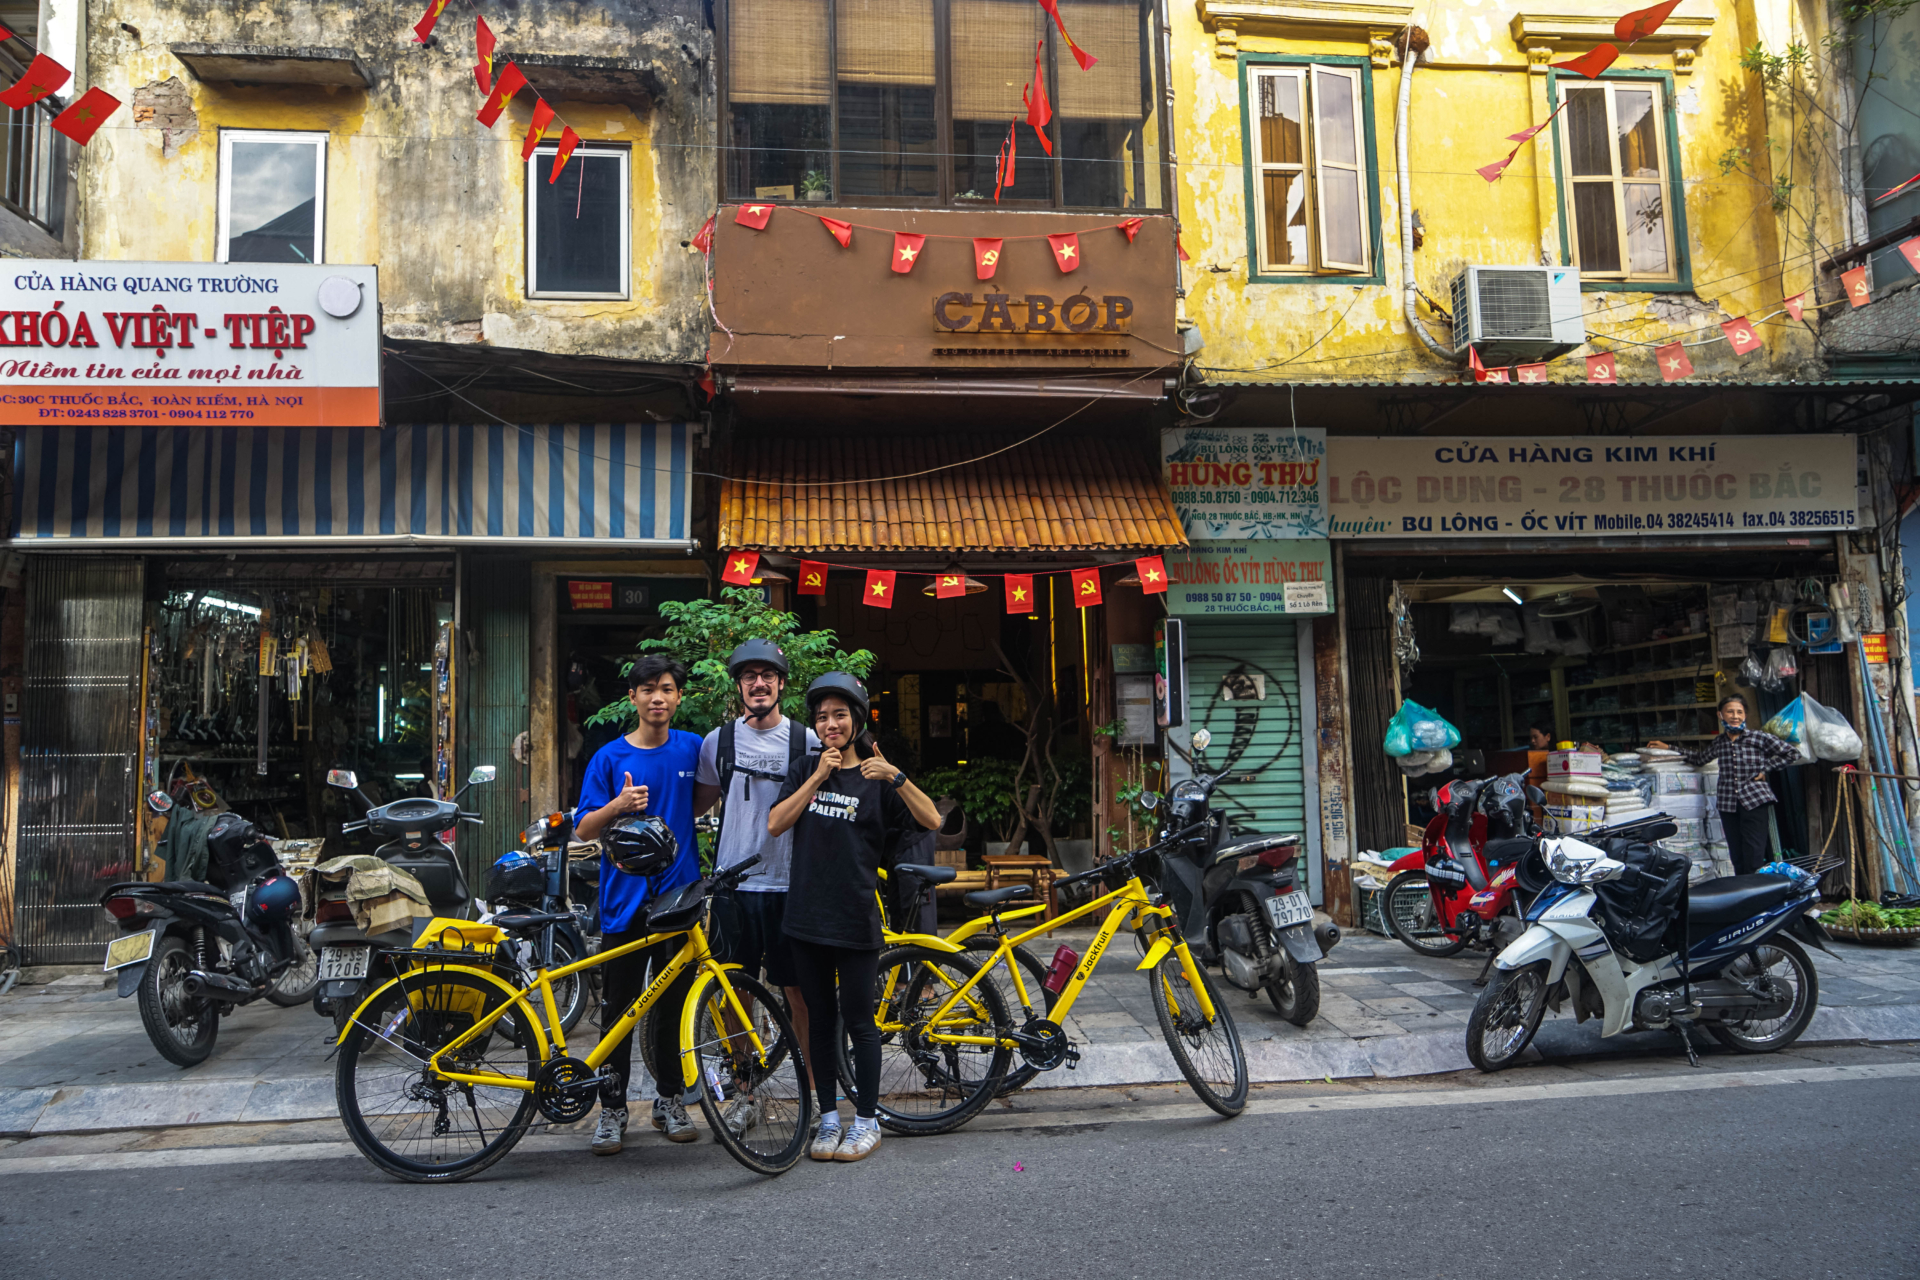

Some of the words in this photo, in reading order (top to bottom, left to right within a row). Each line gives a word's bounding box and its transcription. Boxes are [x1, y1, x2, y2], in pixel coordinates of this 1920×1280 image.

[14, 270, 55, 291] CỬA
[60, 272, 117, 292] HÀNG
[123, 276, 193, 294] QUANG
[198, 274, 279, 294] TRƯỜNG
[103, 304, 198, 359] VIỆT
[224, 306, 316, 360] TIỆP
[0, 359, 80, 378] Niềm
[86, 362, 126, 379] tin
[131, 362, 182, 380] của
[188, 364, 243, 384] mọi
[248, 361, 304, 380] nhà
[49, 392, 104, 405] THUỐC
[247, 394, 270, 406] HÀ
[38, 408, 65, 417] ĐT:
[67, 409, 100, 418] 0243
[102, 410, 127, 418] 828
[129, 410, 159, 418] 3701
[169, 410, 202, 419] 0904
[206, 410, 227, 419] 112
[230, 410, 254, 419] 770
[1435, 442, 1499, 463] CỬA
[1509, 444, 1593, 463] HÀNG
[1606, 447, 1658, 462] KIM
[1669, 442, 1717, 462] KHÍ
[1170, 456, 1252, 486] HÙNG
[1259, 459, 1320, 486] THƯ
[1330, 470, 1402, 509] LỘC
[1417, 476, 1522, 503] DUNG
[1559, 476, 1606, 503] 28
[1616, 464, 1737, 502] THUỐC
[1750, 462, 1822, 499] BẮC
[1328, 514, 1386, 535] huyên
[1402, 516, 1432, 532] BU
[1441, 513, 1499, 532] LÔNG
[1521, 510, 1549, 531] ỐC
[1555, 511, 1588, 531] VÍT
[1668, 512, 1735, 529] 38245414
[1789, 510, 1854, 526] 38256515
[1172, 556, 1220, 585] BULÔNG
[1240, 556, 1261, 584] VÍT
[1264, 556, 1297, 584] HÙNG
[1299, 560, 1325, 582] THƯ
[626, 590, 643, 604] 30
[1186, 593, 1209, 603] 0988
[1212, 593, 1223, 602] 50
[1226, 593, 1236, 602] 87
[1240, 592, 1252, 602] 50
[1260, 592, 1282, 602] 0904
[808, 802, 857, 822] PALETTE
[1272, 894, 1302, 912] 29-D1
[1274, 906, 1311, 926] 797.70
[1718, 918, 1764, 944] SIRIUS
[1084, 931, 1110, 972] Jackfruit
[327, 962, 361, 978] 1206
[637, 965, 674, 1009] Jackfruit
